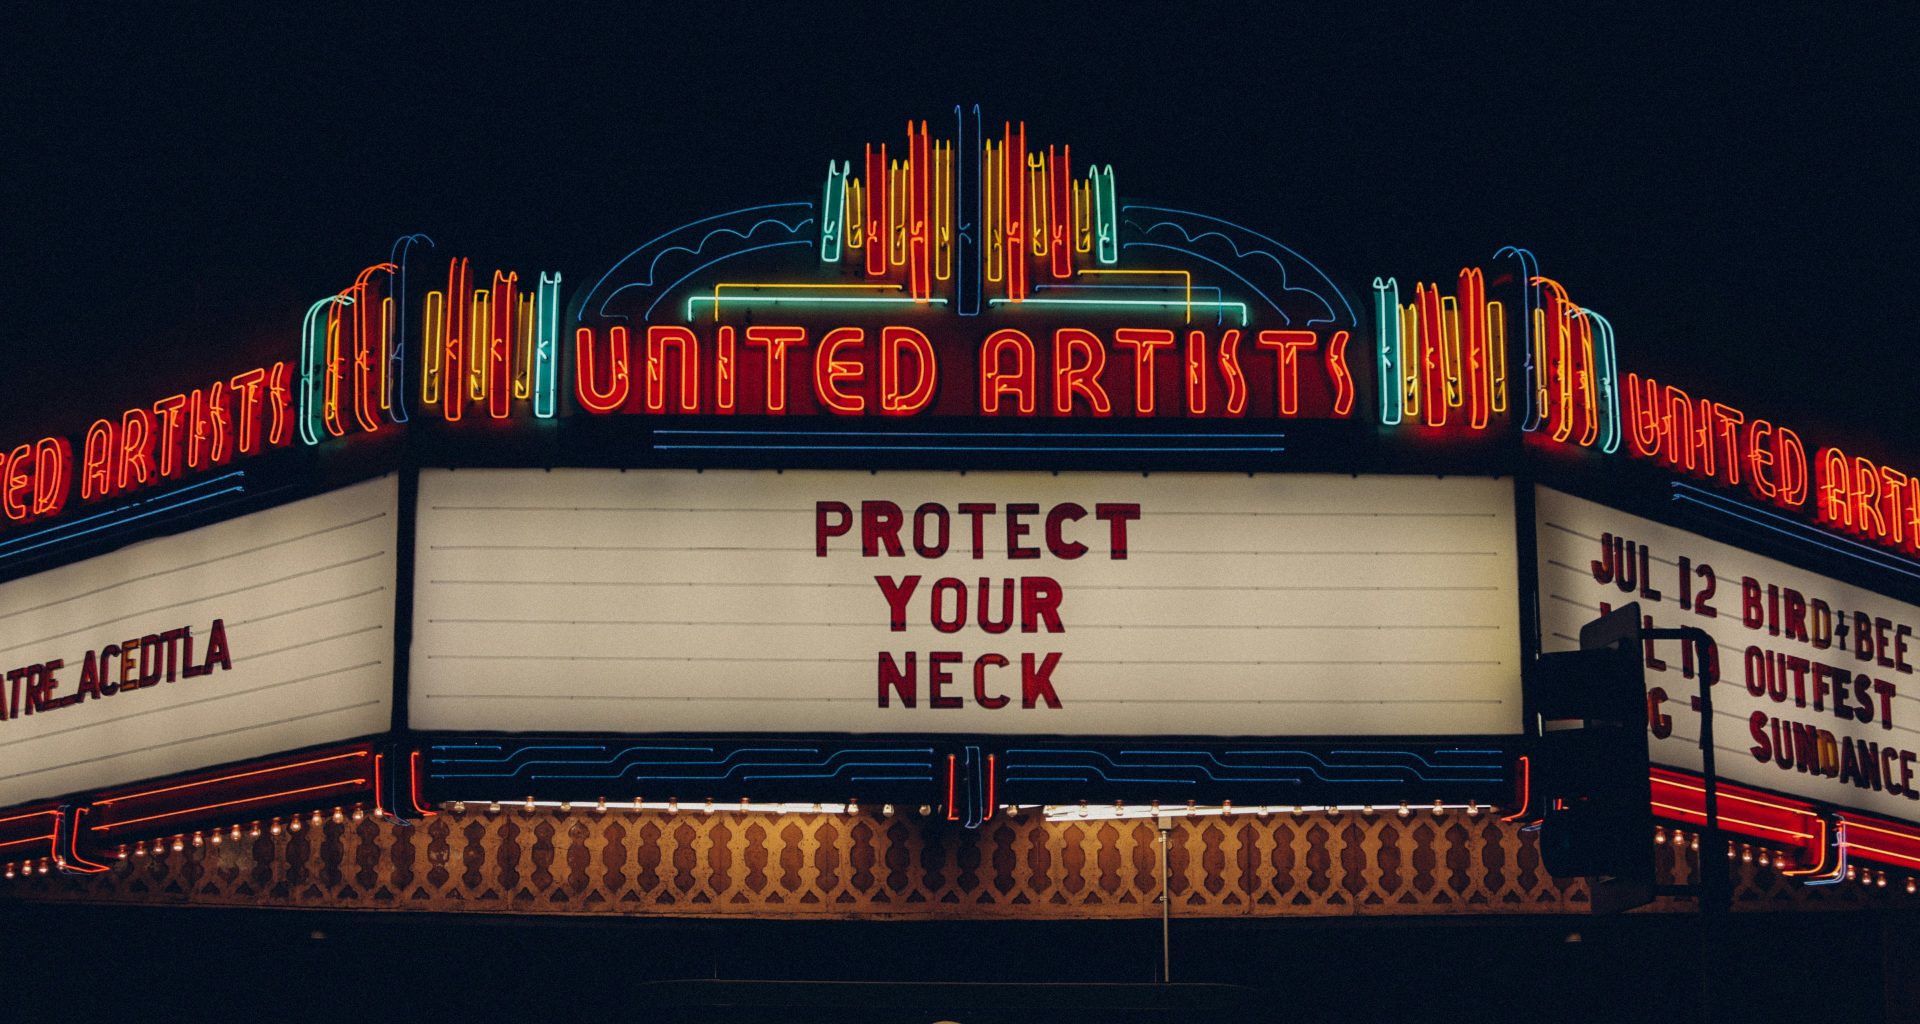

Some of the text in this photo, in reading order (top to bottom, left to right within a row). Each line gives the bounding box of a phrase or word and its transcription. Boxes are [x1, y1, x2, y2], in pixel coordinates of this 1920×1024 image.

[575, 326, 1356, 416] UNITED ARTISTS
[0, 361, 288, 520] ED ARTISTS
[1627, 371, 1808, 506] UNITED
[816, 500, 1141, 560] PROTECT
[874, 575, 1066, 634] YOUR
[1591, 532, 1661, 602] JUL
[1678, 555, 1717, 618] 12
[877, 651, 1063, 710] NECK
[1744, 645, 1896, 730] OUTFEST
[1749, 710, 1920, 801] SUNDANCE
